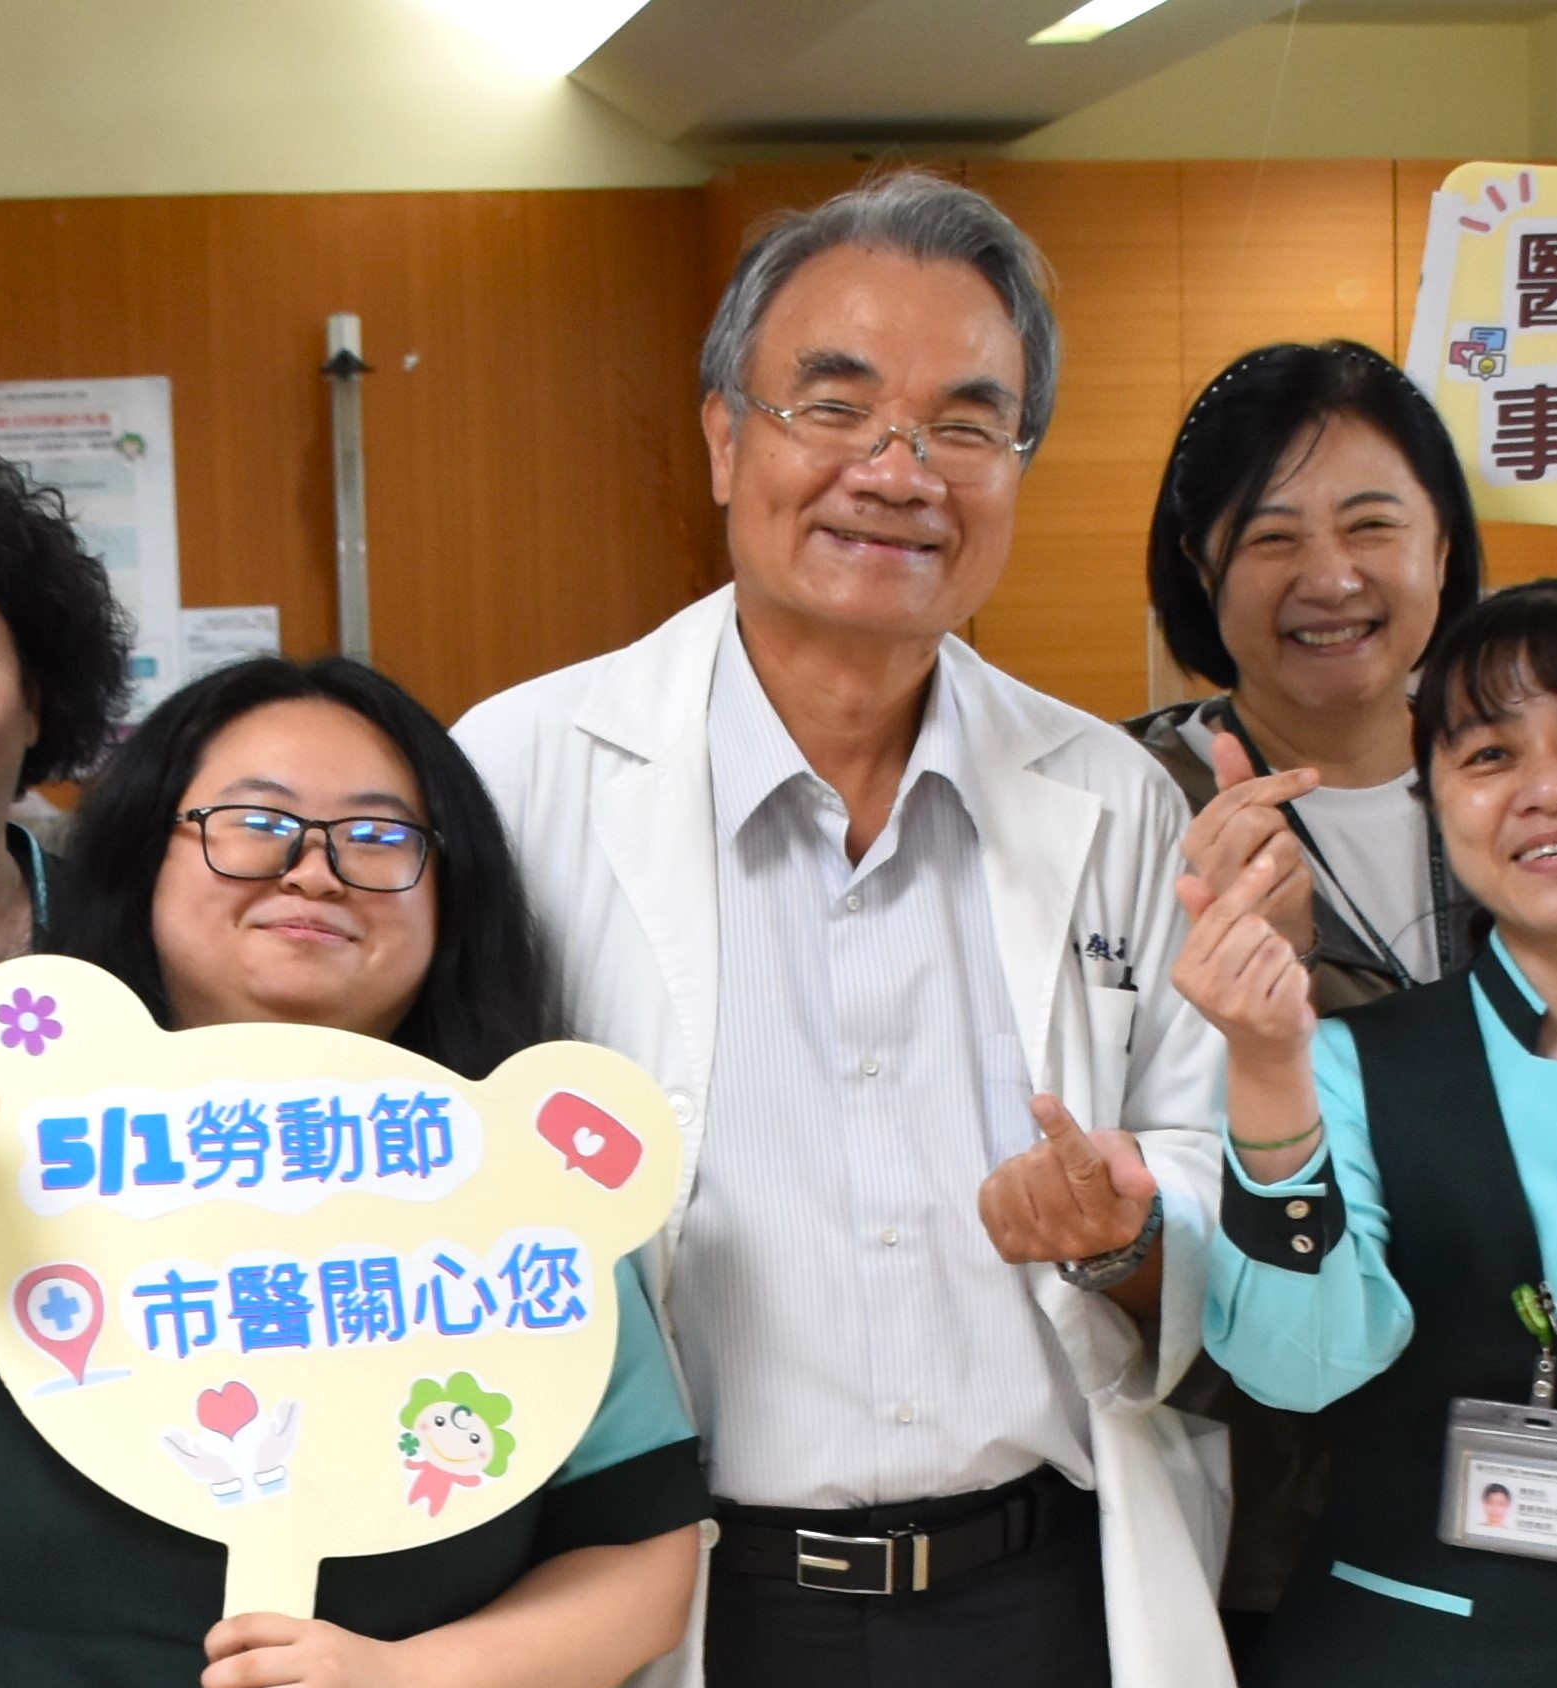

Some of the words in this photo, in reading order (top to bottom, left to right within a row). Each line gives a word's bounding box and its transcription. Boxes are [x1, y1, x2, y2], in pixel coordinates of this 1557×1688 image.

[131, 1242, 587, 1359] 市醫關心您
